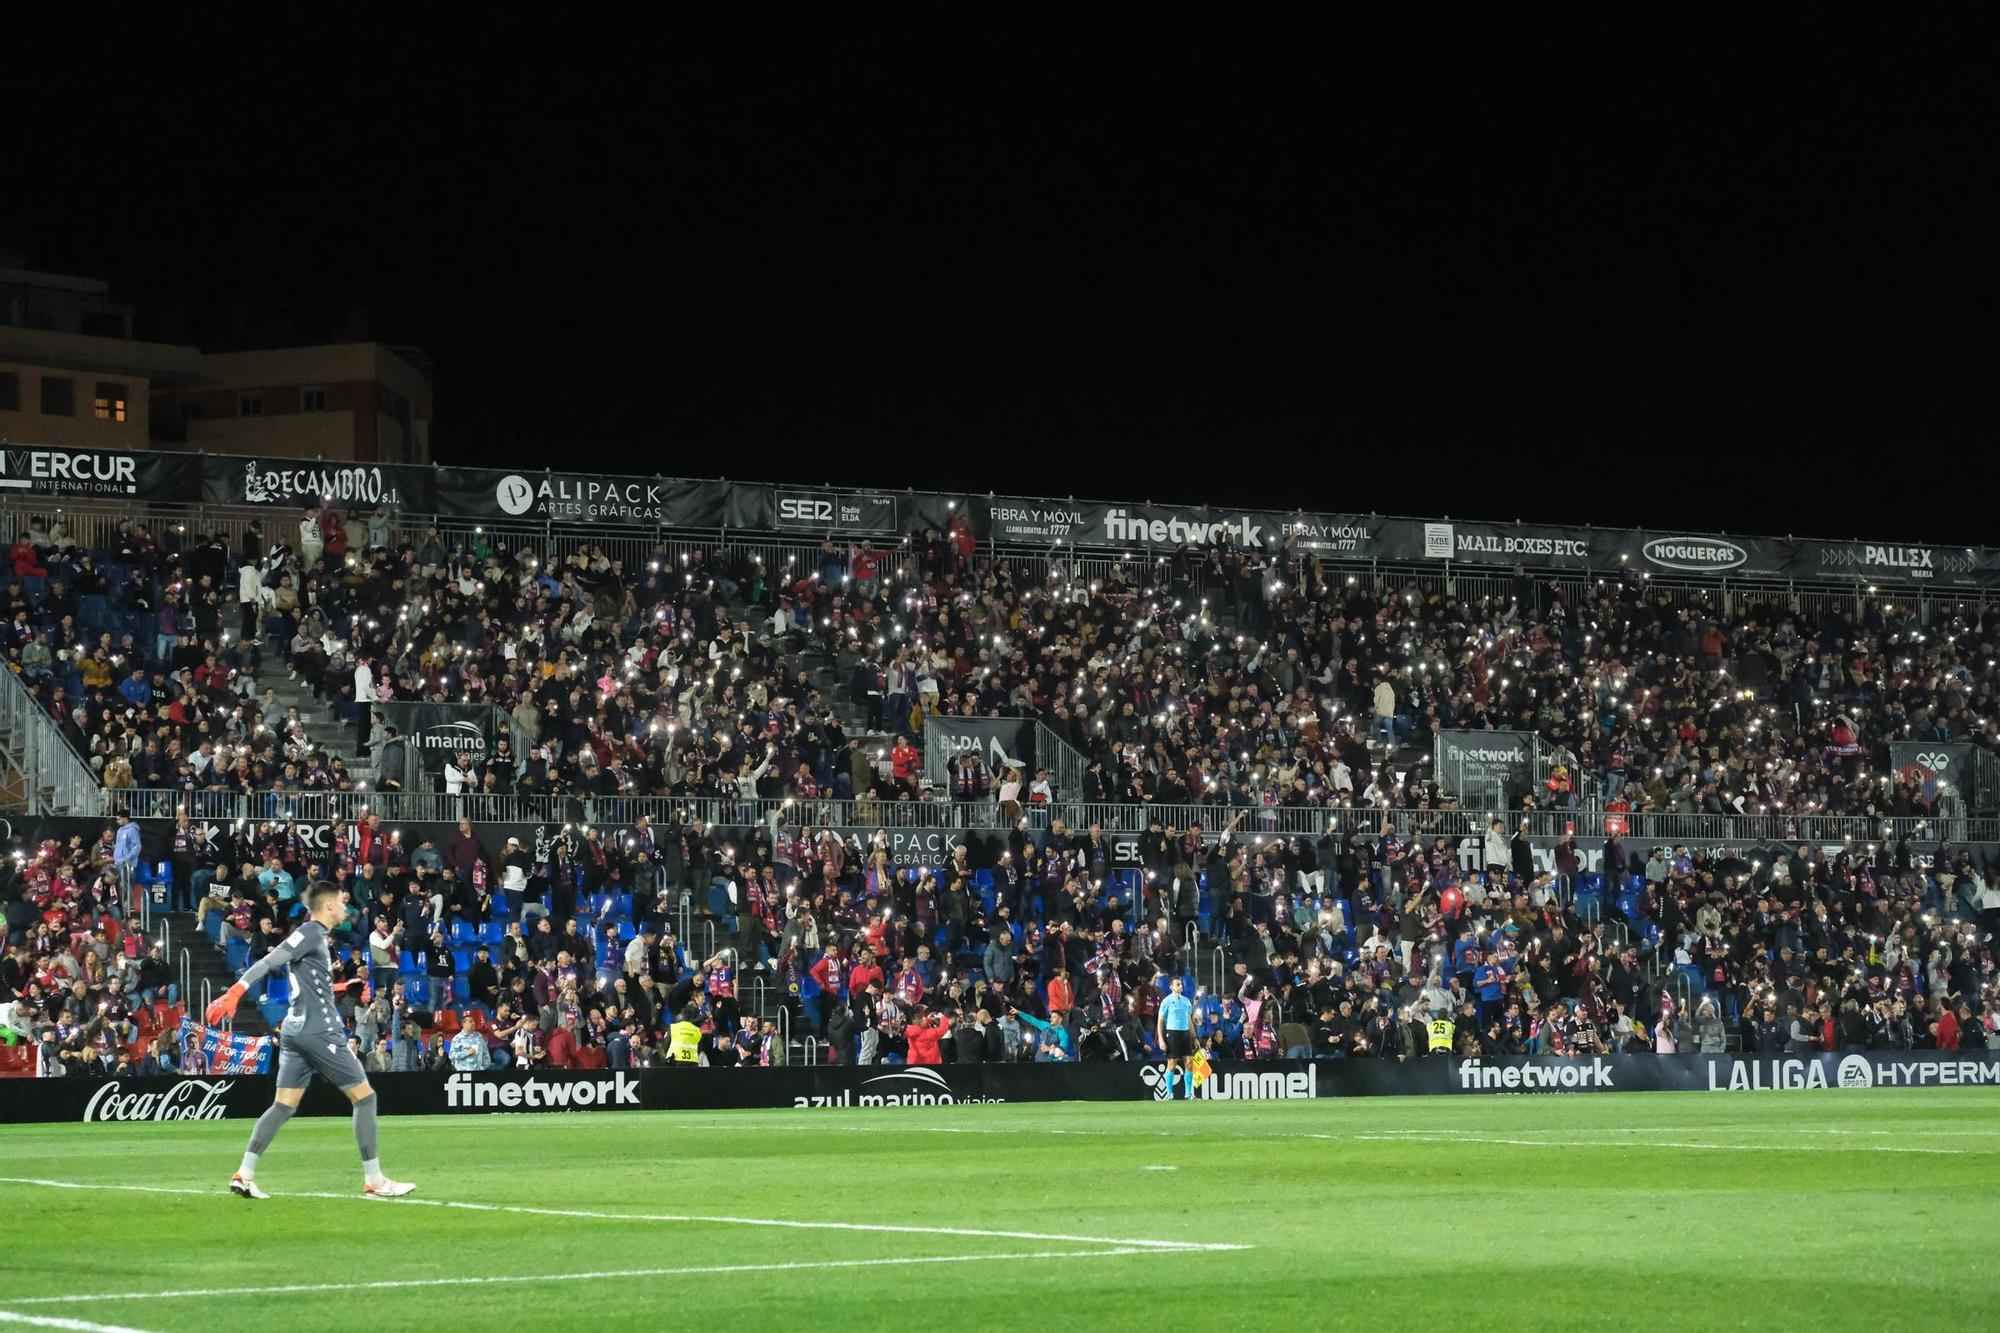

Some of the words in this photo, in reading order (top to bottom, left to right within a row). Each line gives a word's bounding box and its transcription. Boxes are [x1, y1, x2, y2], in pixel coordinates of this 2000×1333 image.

[35, 481, 124, 493] INTERNATIONAL
[262, 467, 382, 504] DECAMBRO
[537, 480, 661, 504] ALIPACK
[537, 502, 582, 515] ARTES
[588, 503, 662, 518] GRÁFICAS
[780, 499, 832, 520] SER
[841, 506, 860, 514] Radio
[990, 507, 1028, 522] FIBRA
[1031, 510, 1040, 522] Y
[1044, 509, 1085, 524] MÓVIL
[1050, 524, 1070, 535] 1777
[1104, 509, 1262, 547] finetwork
[1320, 526, 1328, 537] Y
[1331, 524, 1371, 539] MÓVIL
[1338, 540, 1356, 550] 1777
[1457, 535, 1502, 552] MAIL
[1504, 537, 1553, 554] BOXES
[1655, 545, 1735, 562] NOGUERAS
[1865, 545, 1933, 568] PALLEX
[1911, 570, 1933, 578] IBERIA
[425, 733, 485, 749] marino
[1432, 1022, 1446, 1035] 25
[218, 1045, 237, 1057] POR
[240, 1050, 266, 1062] TODAS
[682, 1050, 691, 1060] 33
[1458, 1057, 1614, 1088] finetwork
[1708, 1059, 1828, 1092] LALIGA
[1844, 1064, 1866, 1079] EA
[444, 1071, 640, 1107] finetwork
[1843, 1079, 1868, 1087] SPORTS
[83, 1079, 236, 1122] Coca-Cola
